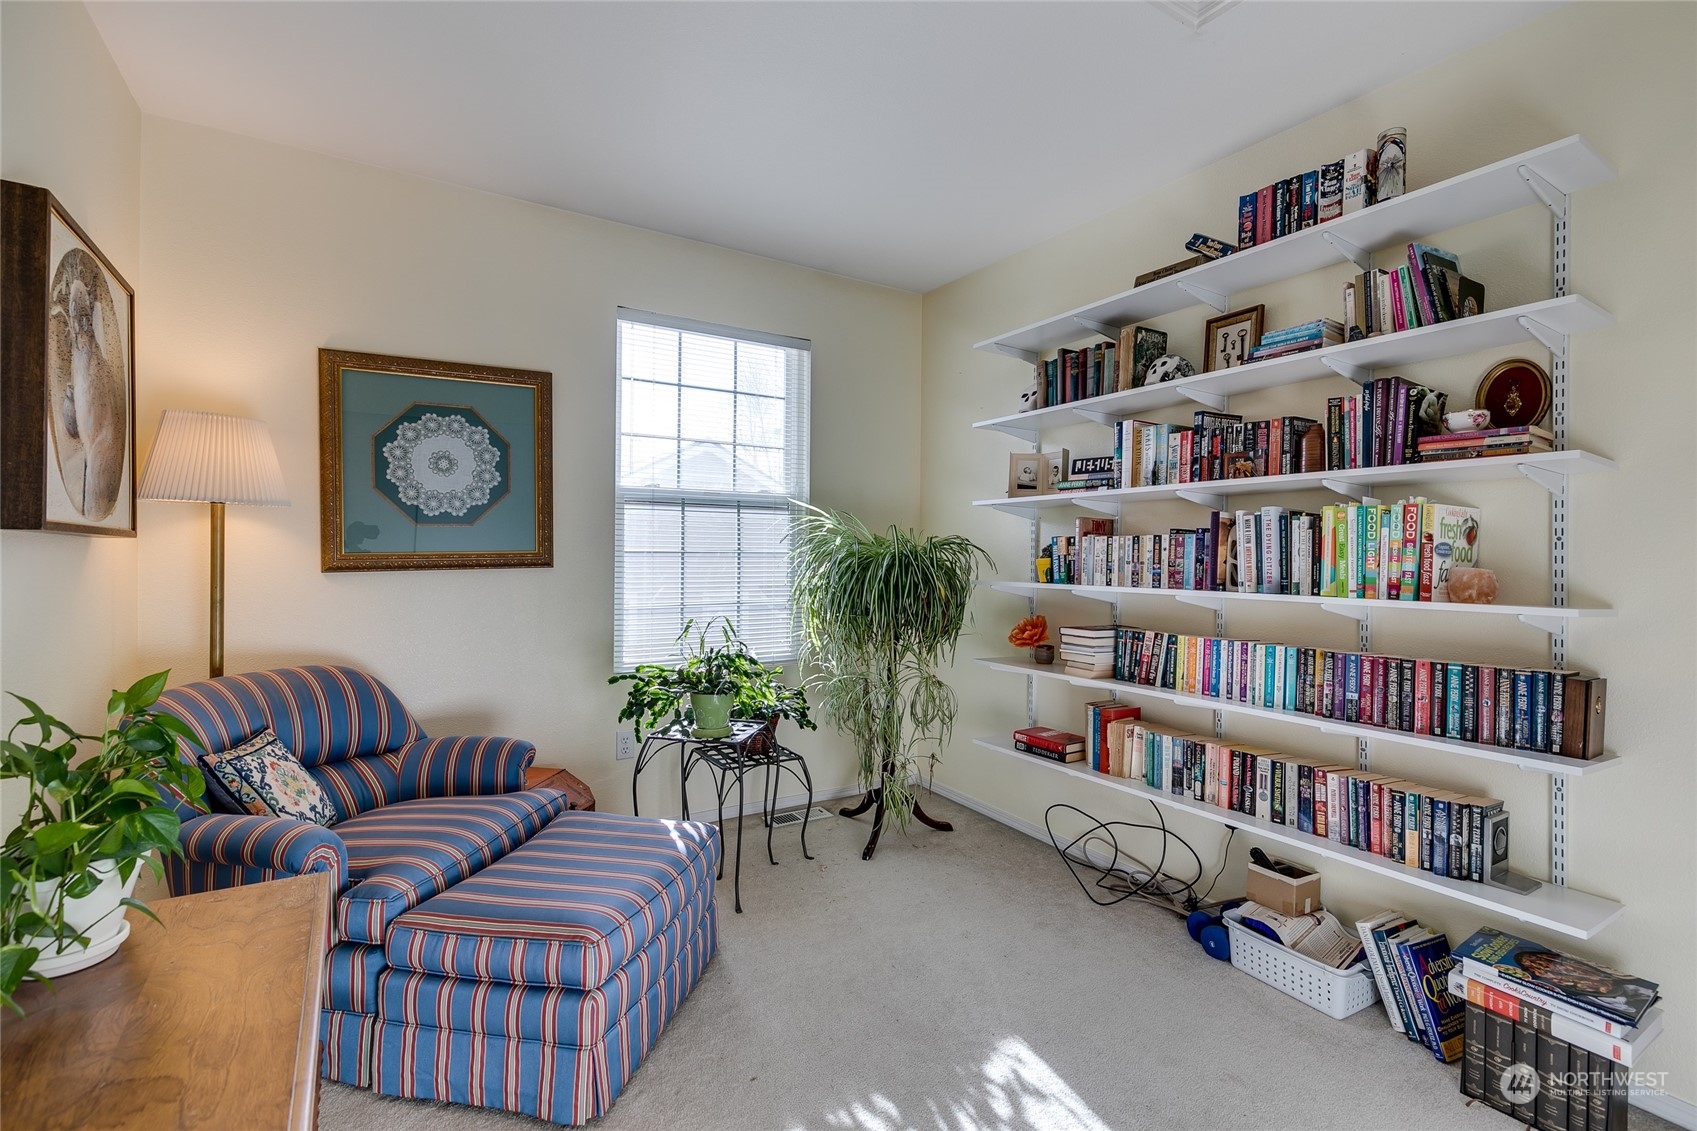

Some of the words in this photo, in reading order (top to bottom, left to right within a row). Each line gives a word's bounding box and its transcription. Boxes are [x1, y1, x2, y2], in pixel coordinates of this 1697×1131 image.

[1135, 429, 1143, 446] NEW
[1144, 428, 1152, 452] PARIS
[1135, 447, 1143, 467] YORK
[1367, 508, 1377, 540] FOOD
[1391, 507, 1400, 539] FOOD
[1406, 507, 1417, 540] FOOD
[1439, 517, 1462, 541] fresh
[1338, 524, 1346, 542] Great
[1337, 543, 1346, 559] Easy
[1367, 542, 1376, 569] LIGHT
[1405, 542, 1414, 558] GREAT
[1423, 543, 1433, 558] fresh
[1450, 541, 1474, 564] food
[1338, 560, 1347, 580] Meals
[1423, 558, 1432, 571] food
[1404, 571, 1412, 584] FAST
[1421, 571, 1431, 585] fast
[1362, 660, 1371, 673] ANNE
[1362, 673, 1371, 686] PERRY
[1389, 668, 1398, 682] ANNE
[1403, 669, 1412, 680] ANNE
[1419, 669, 1427, 682] ANNE
[1435, 670, 1443, 684] ANNE
[1450, 674, 1459, 689] ANNE
[1389, 682, 1397, 696] PERRY
[1403, 680, 1411, 692] PERRY
[1418, 682, 1427, 696] PERRY
[1434, 683, 1442, 698] PERRY
[1499, 679, 1510, 692] ANNE
[1517, 681, 1527, 696] ANNE
[1552, 681, 1562, 695] ANNE
[1450, 689, 1459, 703] PERRY
[1517, 696, 1527, 711] PERRY
[1552, 695, 1562, 710] PERRY
[1032, 747, 1042, 755] TED
[1041, 749, 1059, 759] DEKKER
[1274, 769, 1282, 787] WILBUR
[1273, 788, 1281, 804] SMITH
[1372, 793, 1380, 805] ANNE
[1393, 800, 1403, 815] ANNE
[1408, 803, 1416, 816] ANNE
[1423, 804, 1432, 816] ANNE
[1393, 815, 1402, 828] PERRY
[1408, 816, 1416, 830] PERRY
[1422, 816, 1432, 829] PERRY
[1472, 814, 1481, 828] ANNE
[1472, 828, 1481, 845] PERRY
[1360, 925, 1371, 947] DANIEL
[1366, 945, 1383, 975] GOLEMAN
[1482, 975, 1502, 987] COMPLETE
[1391, 986, 1403, 1002] Daniel
[1501, 972, 1522, 985] EVERYDAY
[1534, 984, 1552, 996] COOKER
[1577, 1001, 1598, 1012] RECIPES
[1437, 992, 1450, 1014] @
[1396, 1001, 1409, 1024] Goleman
